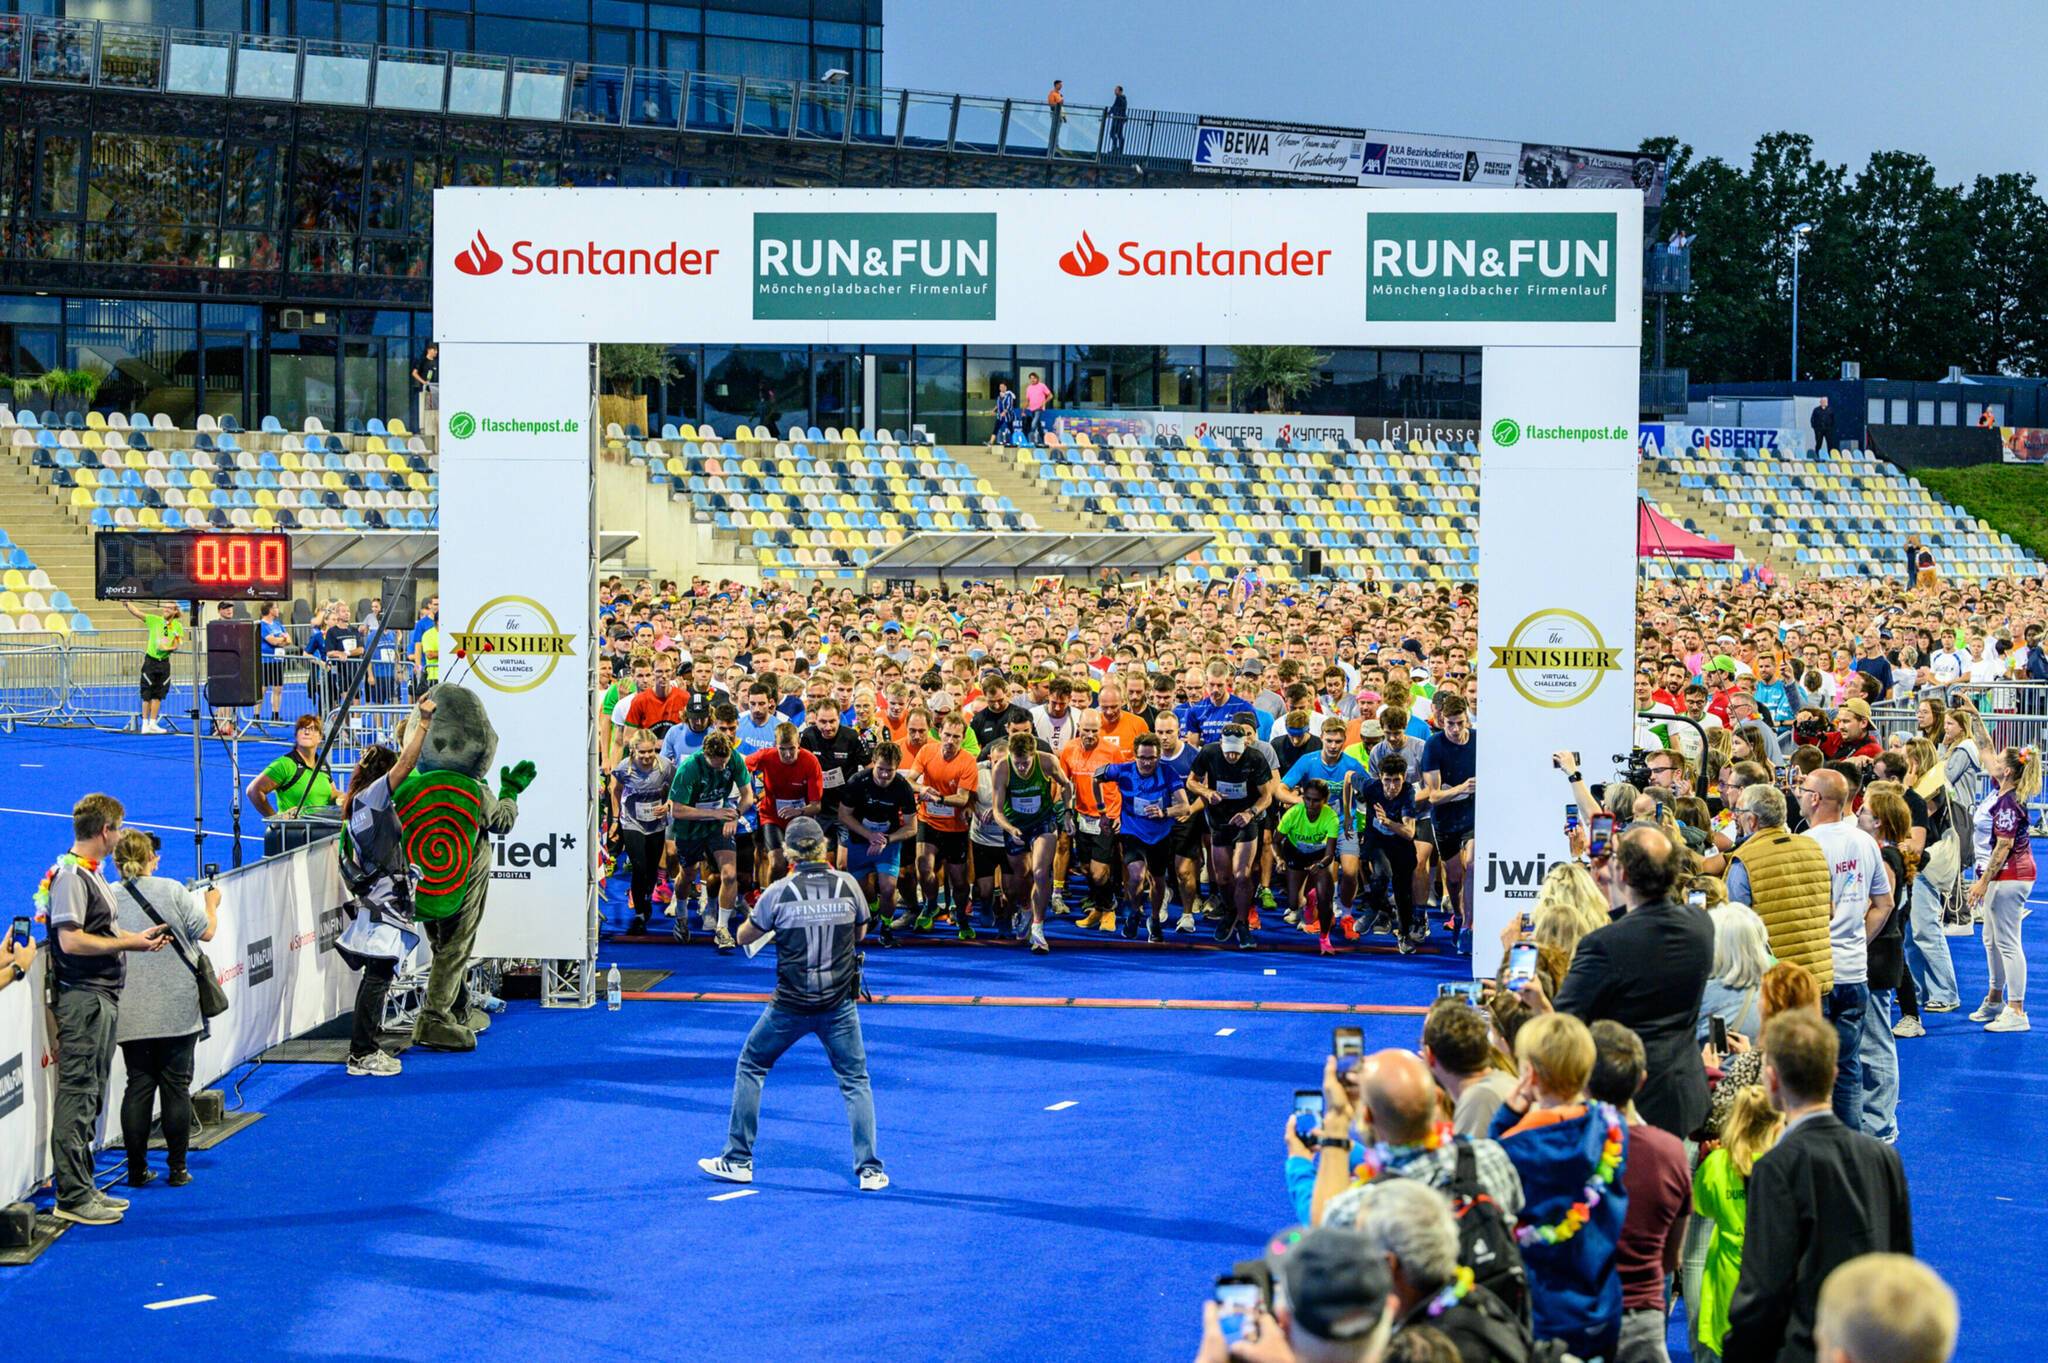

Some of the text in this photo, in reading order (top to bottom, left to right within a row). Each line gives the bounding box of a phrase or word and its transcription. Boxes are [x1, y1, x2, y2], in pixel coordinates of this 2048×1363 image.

[1224, 131, 1268, 156] BEWA
[1389, 145, 1464, 159] AXA Bezirksdirektion
[1222, 154, 1249, 167] Gruppe
[1387, 157, 1419, 166] THORSTEN
[1485, 161, 1512, 169] PREMIUM
[1484, 168, 1510, 177] PARTNER
[512, 240, 719, 276] Santander
[760, 239, 988, 277] RUN&FUN
[1118, 241, 1332, 277] Santander
[1372, 240, 1608, 278] RUN&FUN
[760, 282, 988, 297] Mönchengladbacher Firmenlauf
[1372, 284, 1607, 299] Mönchengladbacher Firmenlauf
[482, 418, 579, 436] flaschenpost.de
[1526, 425, 1629, 443] flaschenpost.de
[1691, 428, 1778, 450] GISBERTZ
[197, 540, 283, 581] 0:00
[127, 586, 137, 594] 23
[506, 618, 520, 631] the
[462, 636, 564, 653] FINISHER
[1549, 632, 1563, 644] the
[1502, 650, 1610, 667] FINISHER
[1484, 852, 1568, 893] jwi
[1835, 859, 1857, 874] NEW
[1507, 890, 1535, 898] STARK
